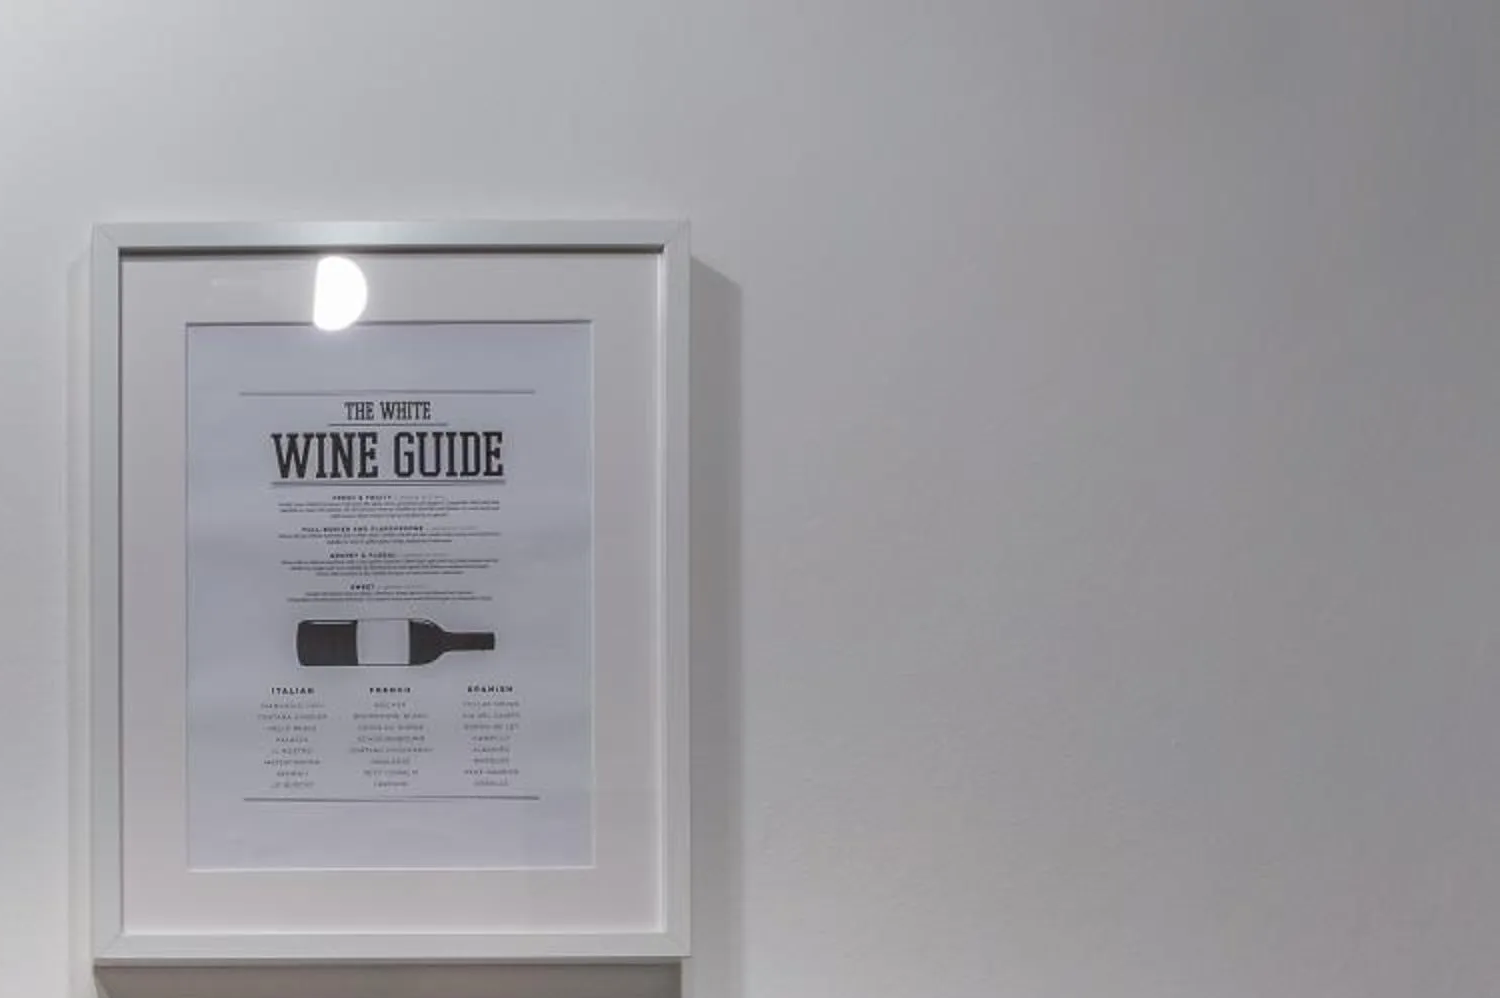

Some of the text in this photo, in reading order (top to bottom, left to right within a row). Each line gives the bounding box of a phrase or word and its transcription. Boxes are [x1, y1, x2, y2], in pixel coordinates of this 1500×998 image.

[344, 401, 431, 421] THE WHITE
[271, 431, 504, 479] WINE GUIDE
